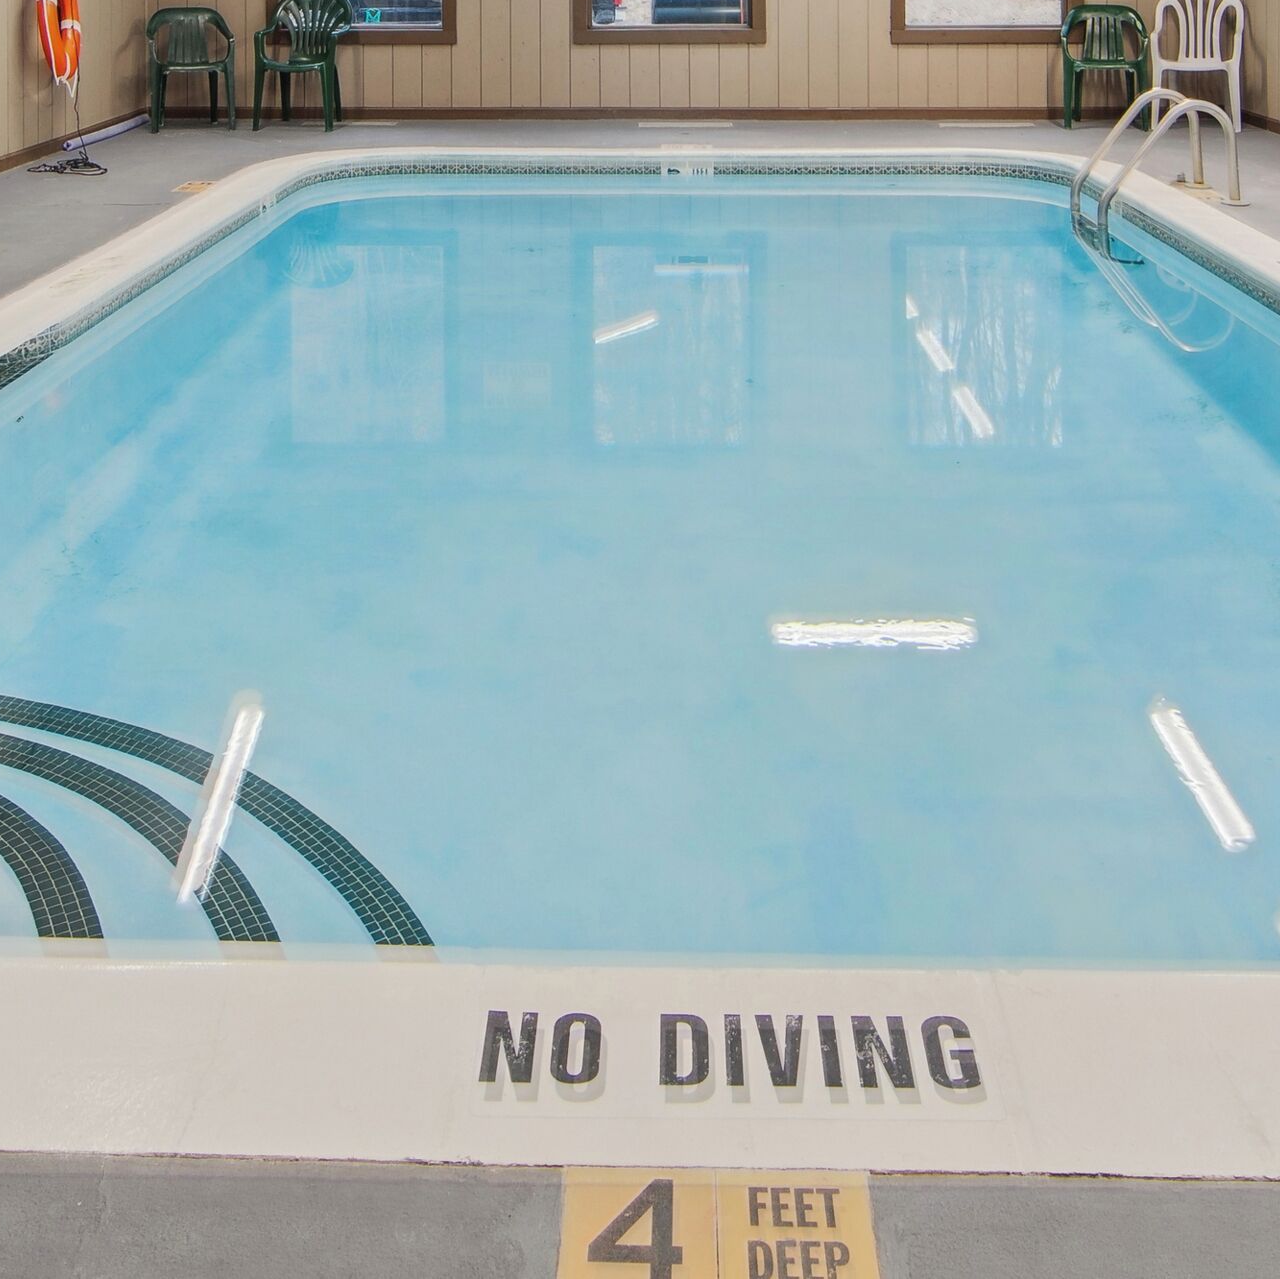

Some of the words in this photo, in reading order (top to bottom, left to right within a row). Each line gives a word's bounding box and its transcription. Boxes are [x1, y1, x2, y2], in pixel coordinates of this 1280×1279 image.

[478, 1010, 603, 1084] NO
[659, 1013, 982, 1089] DIVING
[587, 1178, 683, 1279] 4
[748, 1186, 840, 1228] FEET
[747, 1239, 850, 1279] DEEP
